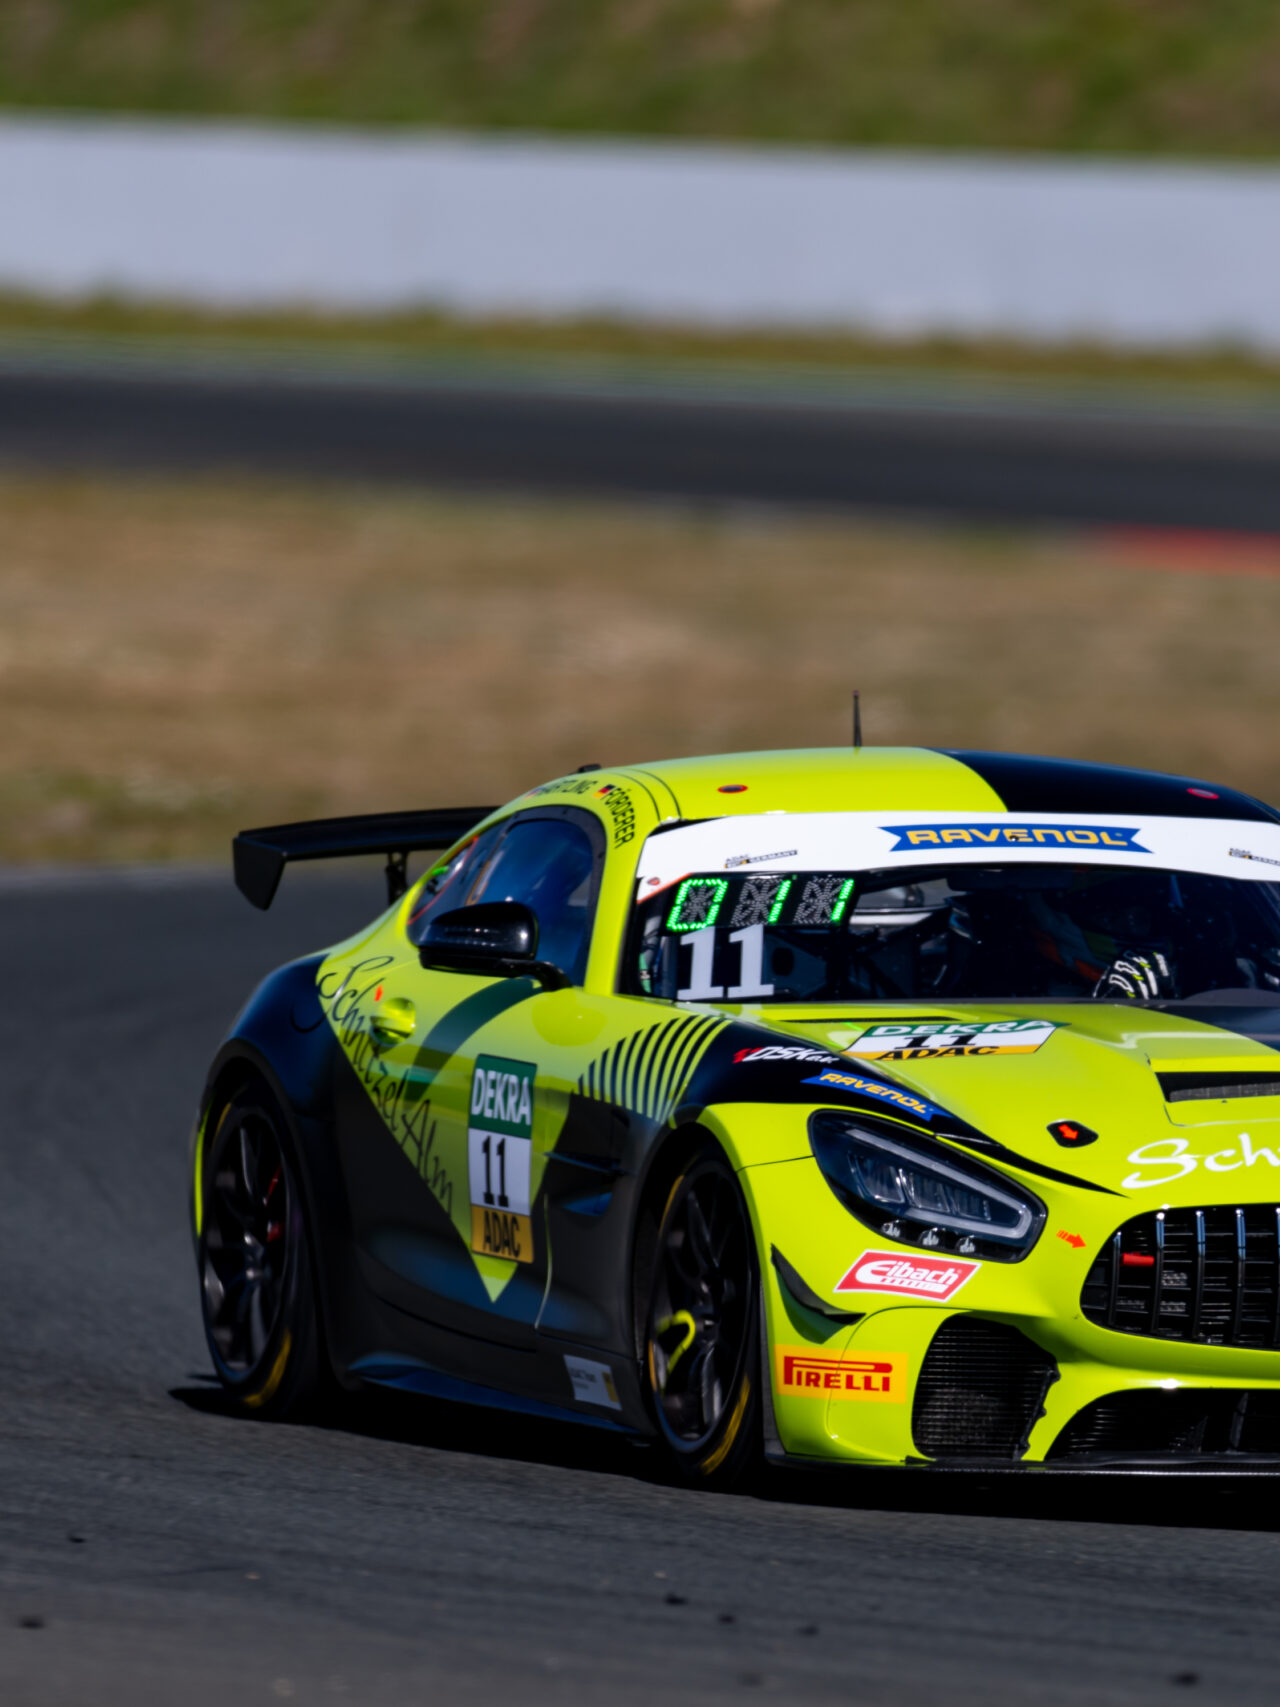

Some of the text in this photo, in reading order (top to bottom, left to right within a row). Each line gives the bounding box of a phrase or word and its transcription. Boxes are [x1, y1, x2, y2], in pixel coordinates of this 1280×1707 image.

[600, 788, 635, 849] FÖRDERER
[905, 829, 1129, 847] RAVENOL
[677, 924, 774, 1000] 11
[871, 1020, 1052, 1036] DEKRA
[894, 1033, 979, 1050] 11
[874, 1046, 1000, 1061] ADAC
[471, 1068, 532, 1126] DEKRA
[820, 1072, 926, 1114] RAVENOL
[482, 1135, 510, 1208] 11
[482, 1209, 521, 1258] ADAC
[855, 1260, 960, 1292] Eibach
[783, 1355, 893, 1393] PIRELLI
